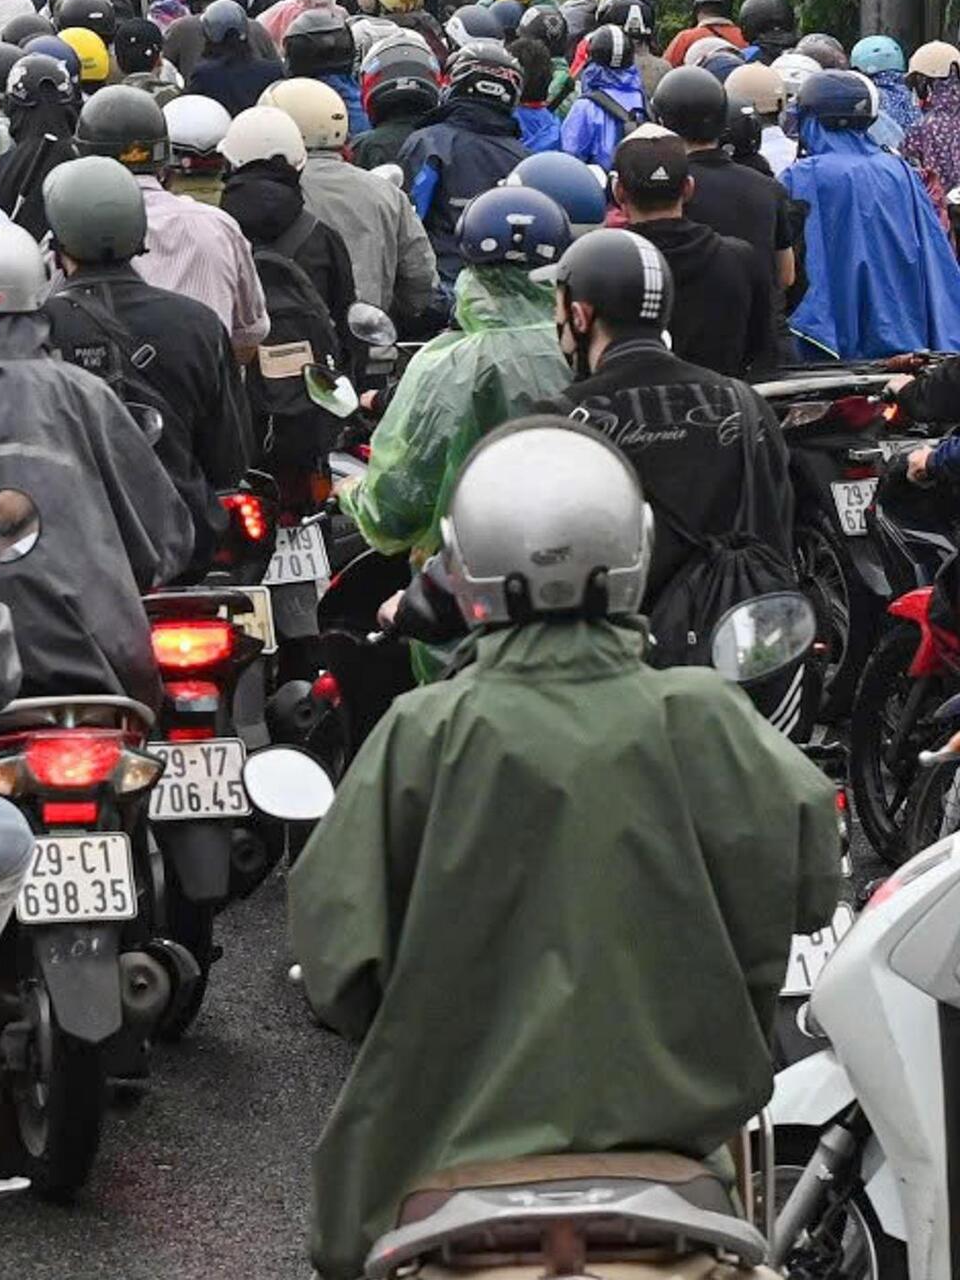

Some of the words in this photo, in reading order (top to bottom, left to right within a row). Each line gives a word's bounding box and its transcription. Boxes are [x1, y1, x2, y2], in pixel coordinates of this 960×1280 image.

[157, 746, 228, 779] 29-Y7
[154, 781, 243, 815] 706.45
[31, 839, 112, 878] 29-C1
[23, 878, 128, 917] 698.35
